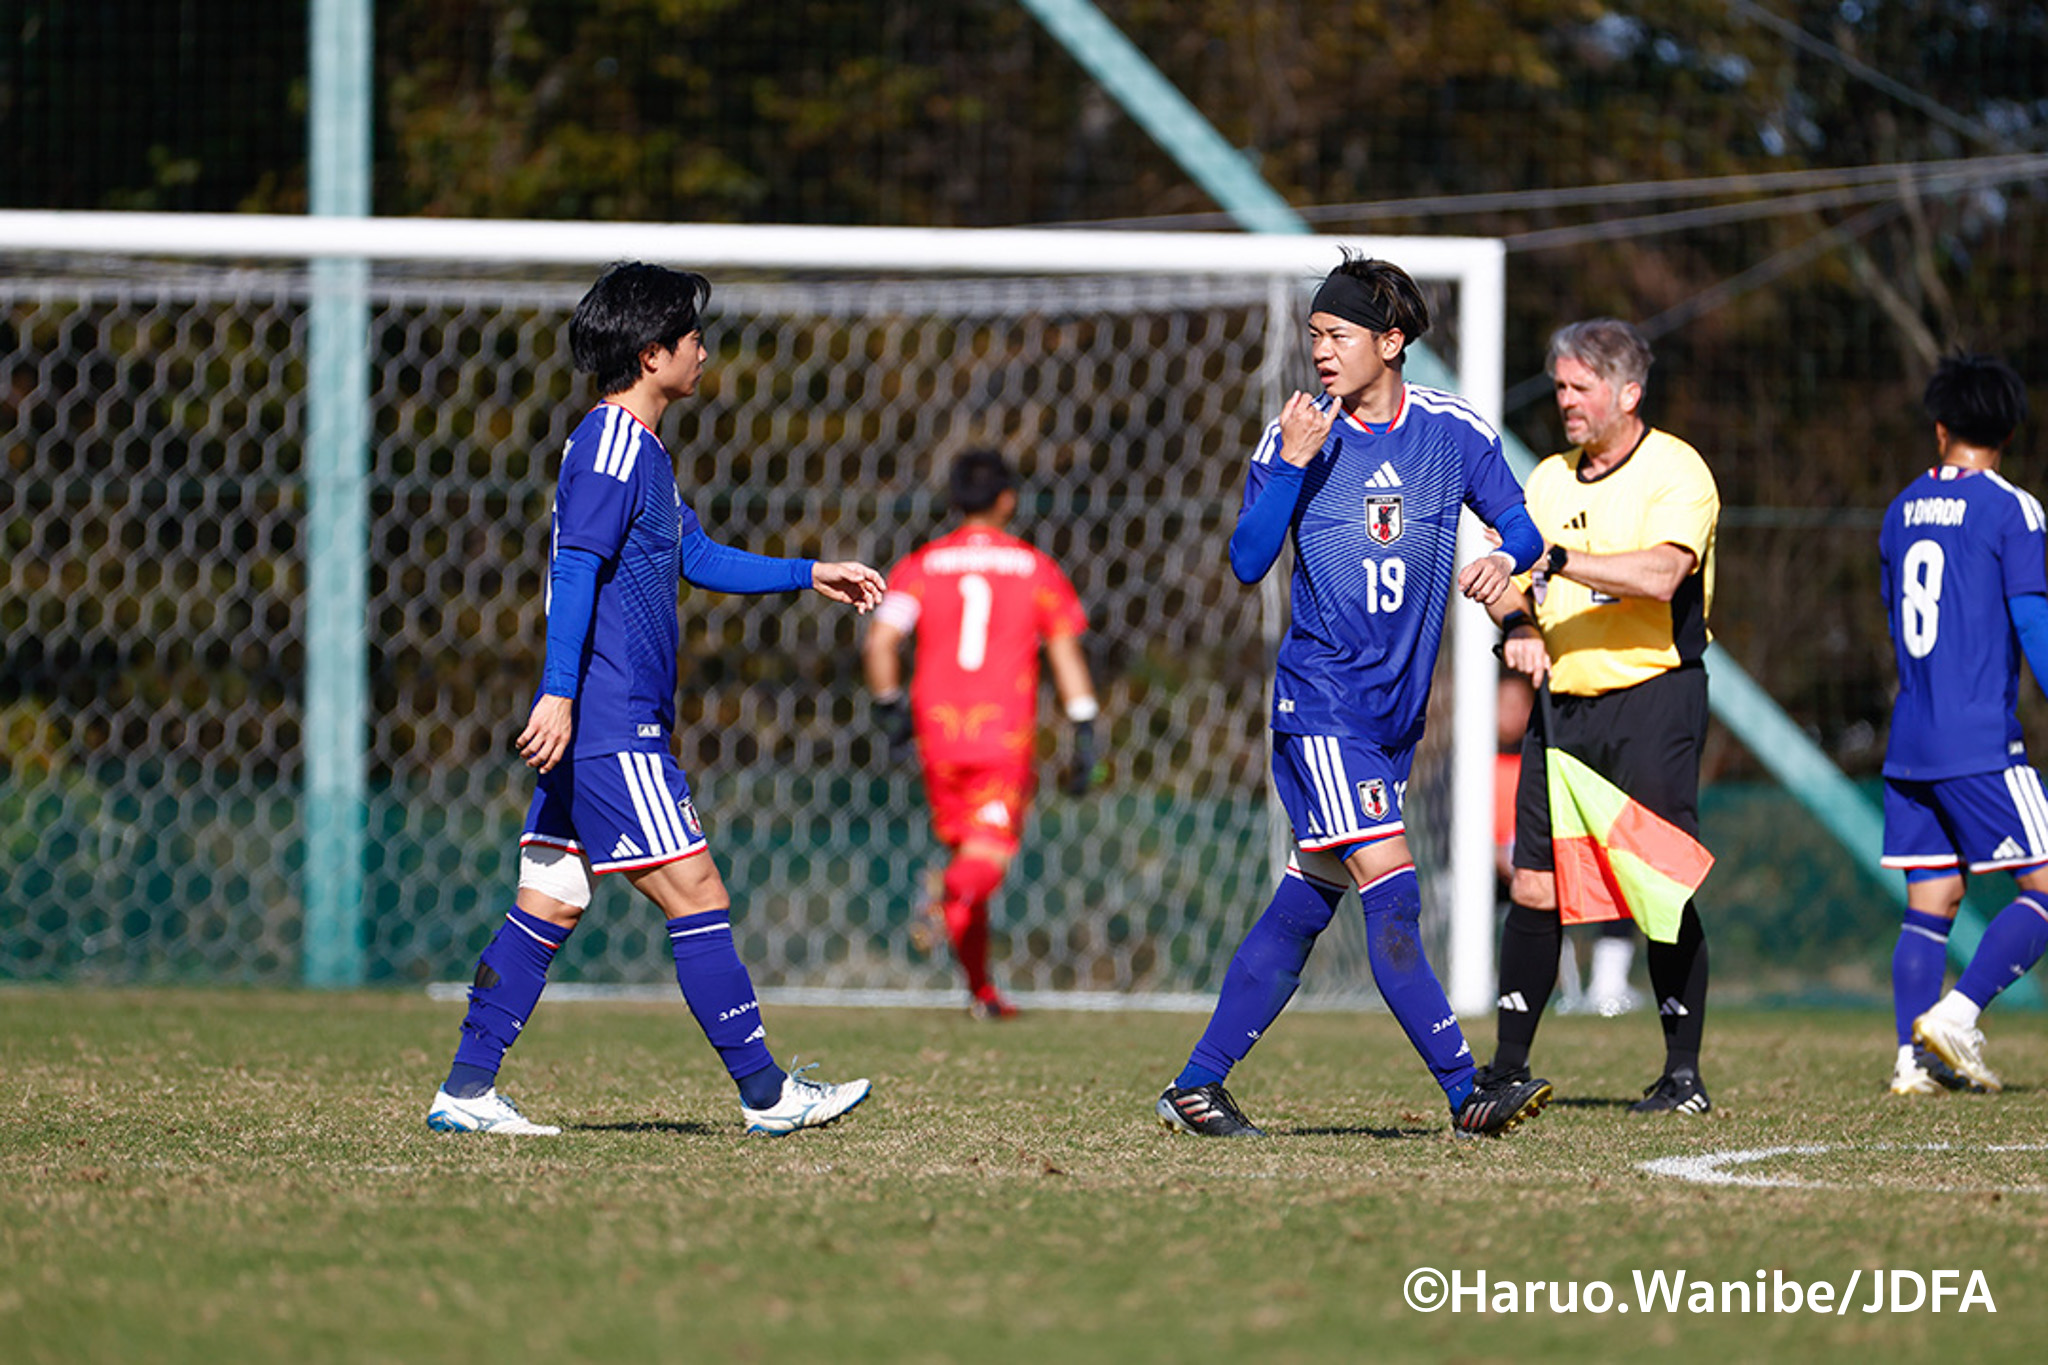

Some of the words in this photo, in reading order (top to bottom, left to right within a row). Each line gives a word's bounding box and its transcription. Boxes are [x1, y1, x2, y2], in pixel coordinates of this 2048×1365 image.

[958, 573, 992, 672] 1
[1362, 556, 1406, 614] 19
[1902, 539, 1945, 659] 8
